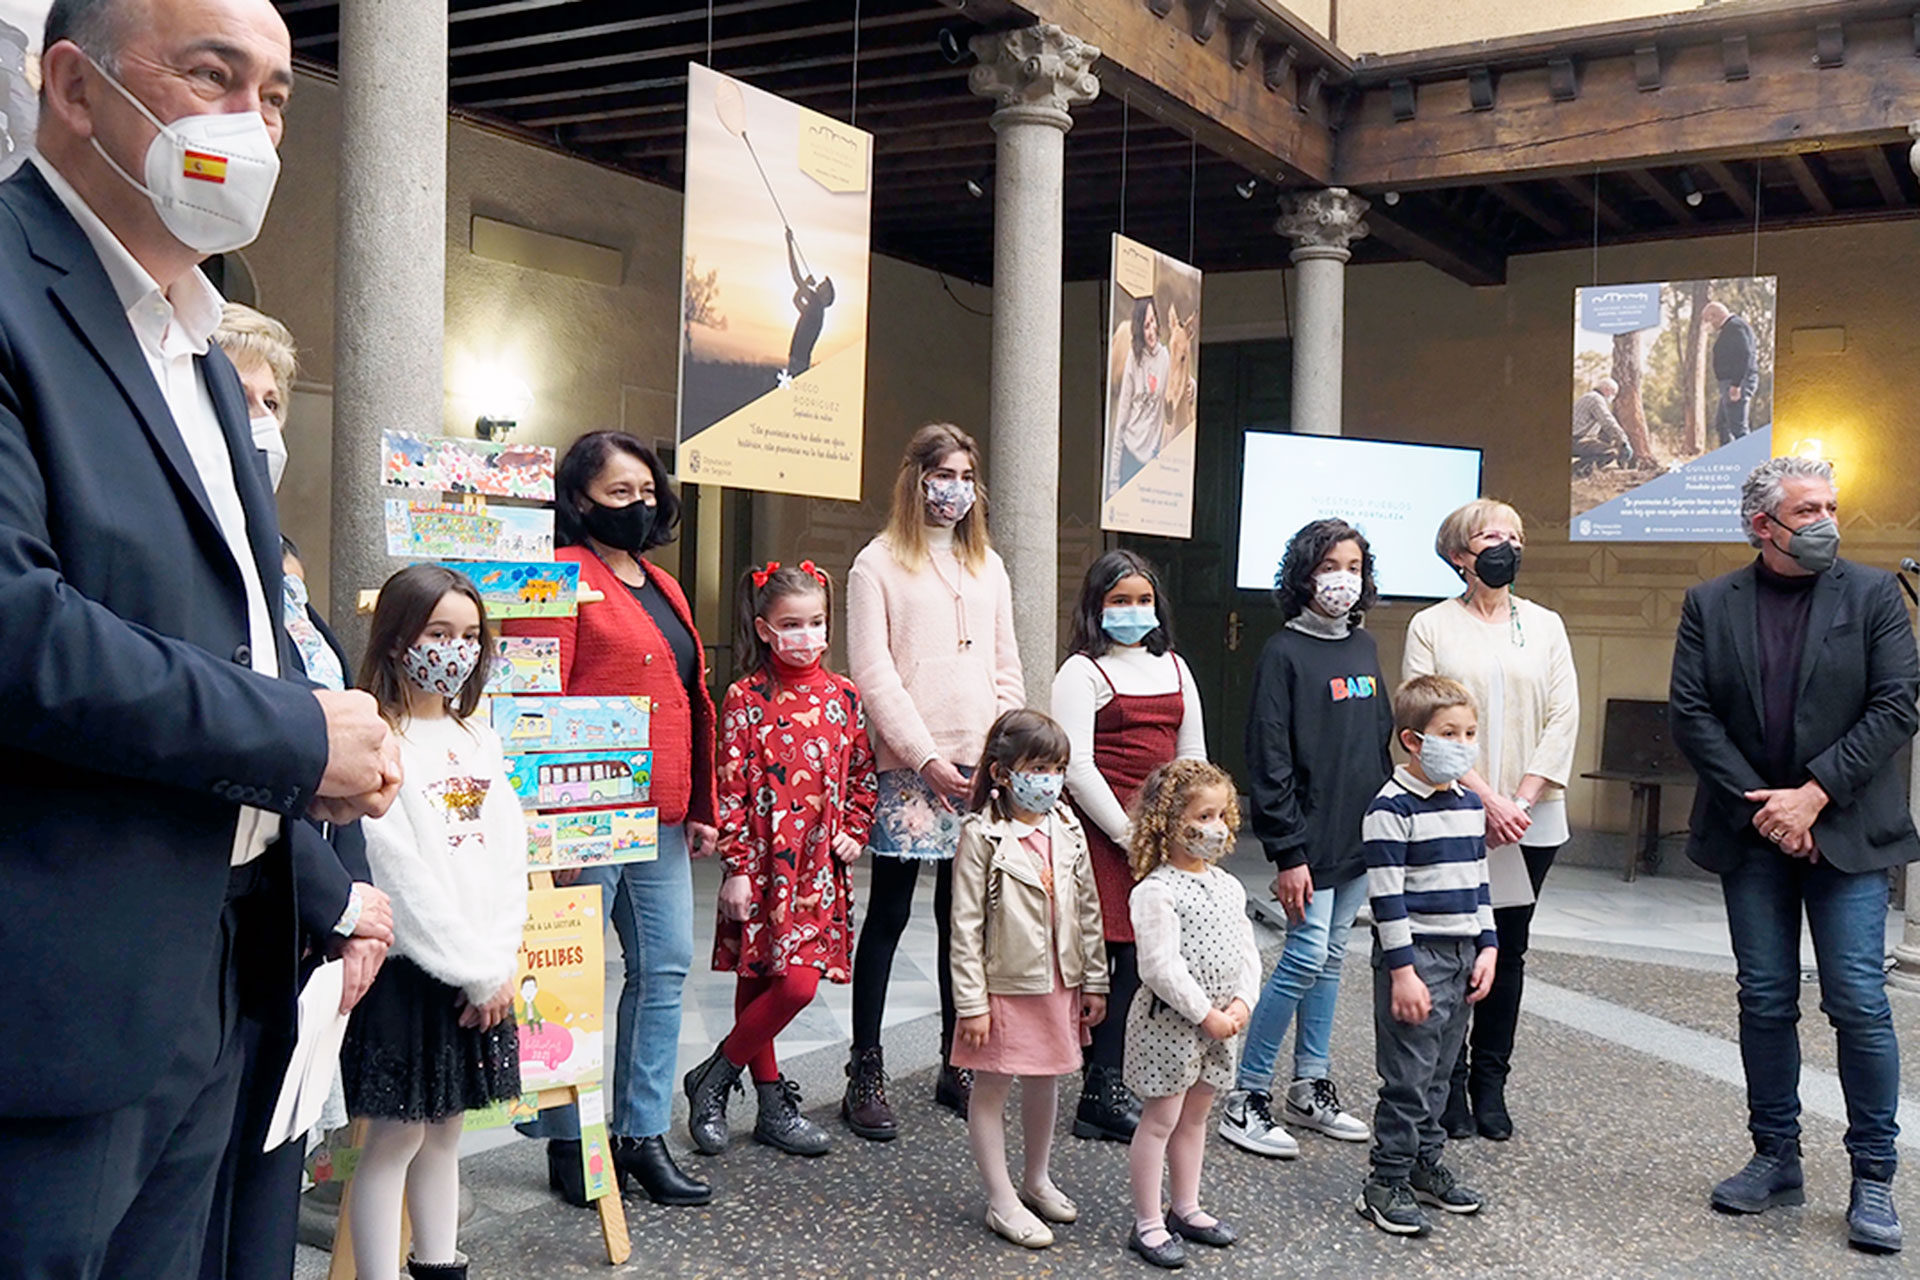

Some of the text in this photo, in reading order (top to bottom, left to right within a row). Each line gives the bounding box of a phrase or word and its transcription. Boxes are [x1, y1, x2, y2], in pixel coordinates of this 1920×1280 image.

[1685, 464, 1741, 472] GUILLERMO
[1685, 474, 1731, 482] HERRERO
[527, 945, 584, 970] DELIBES
